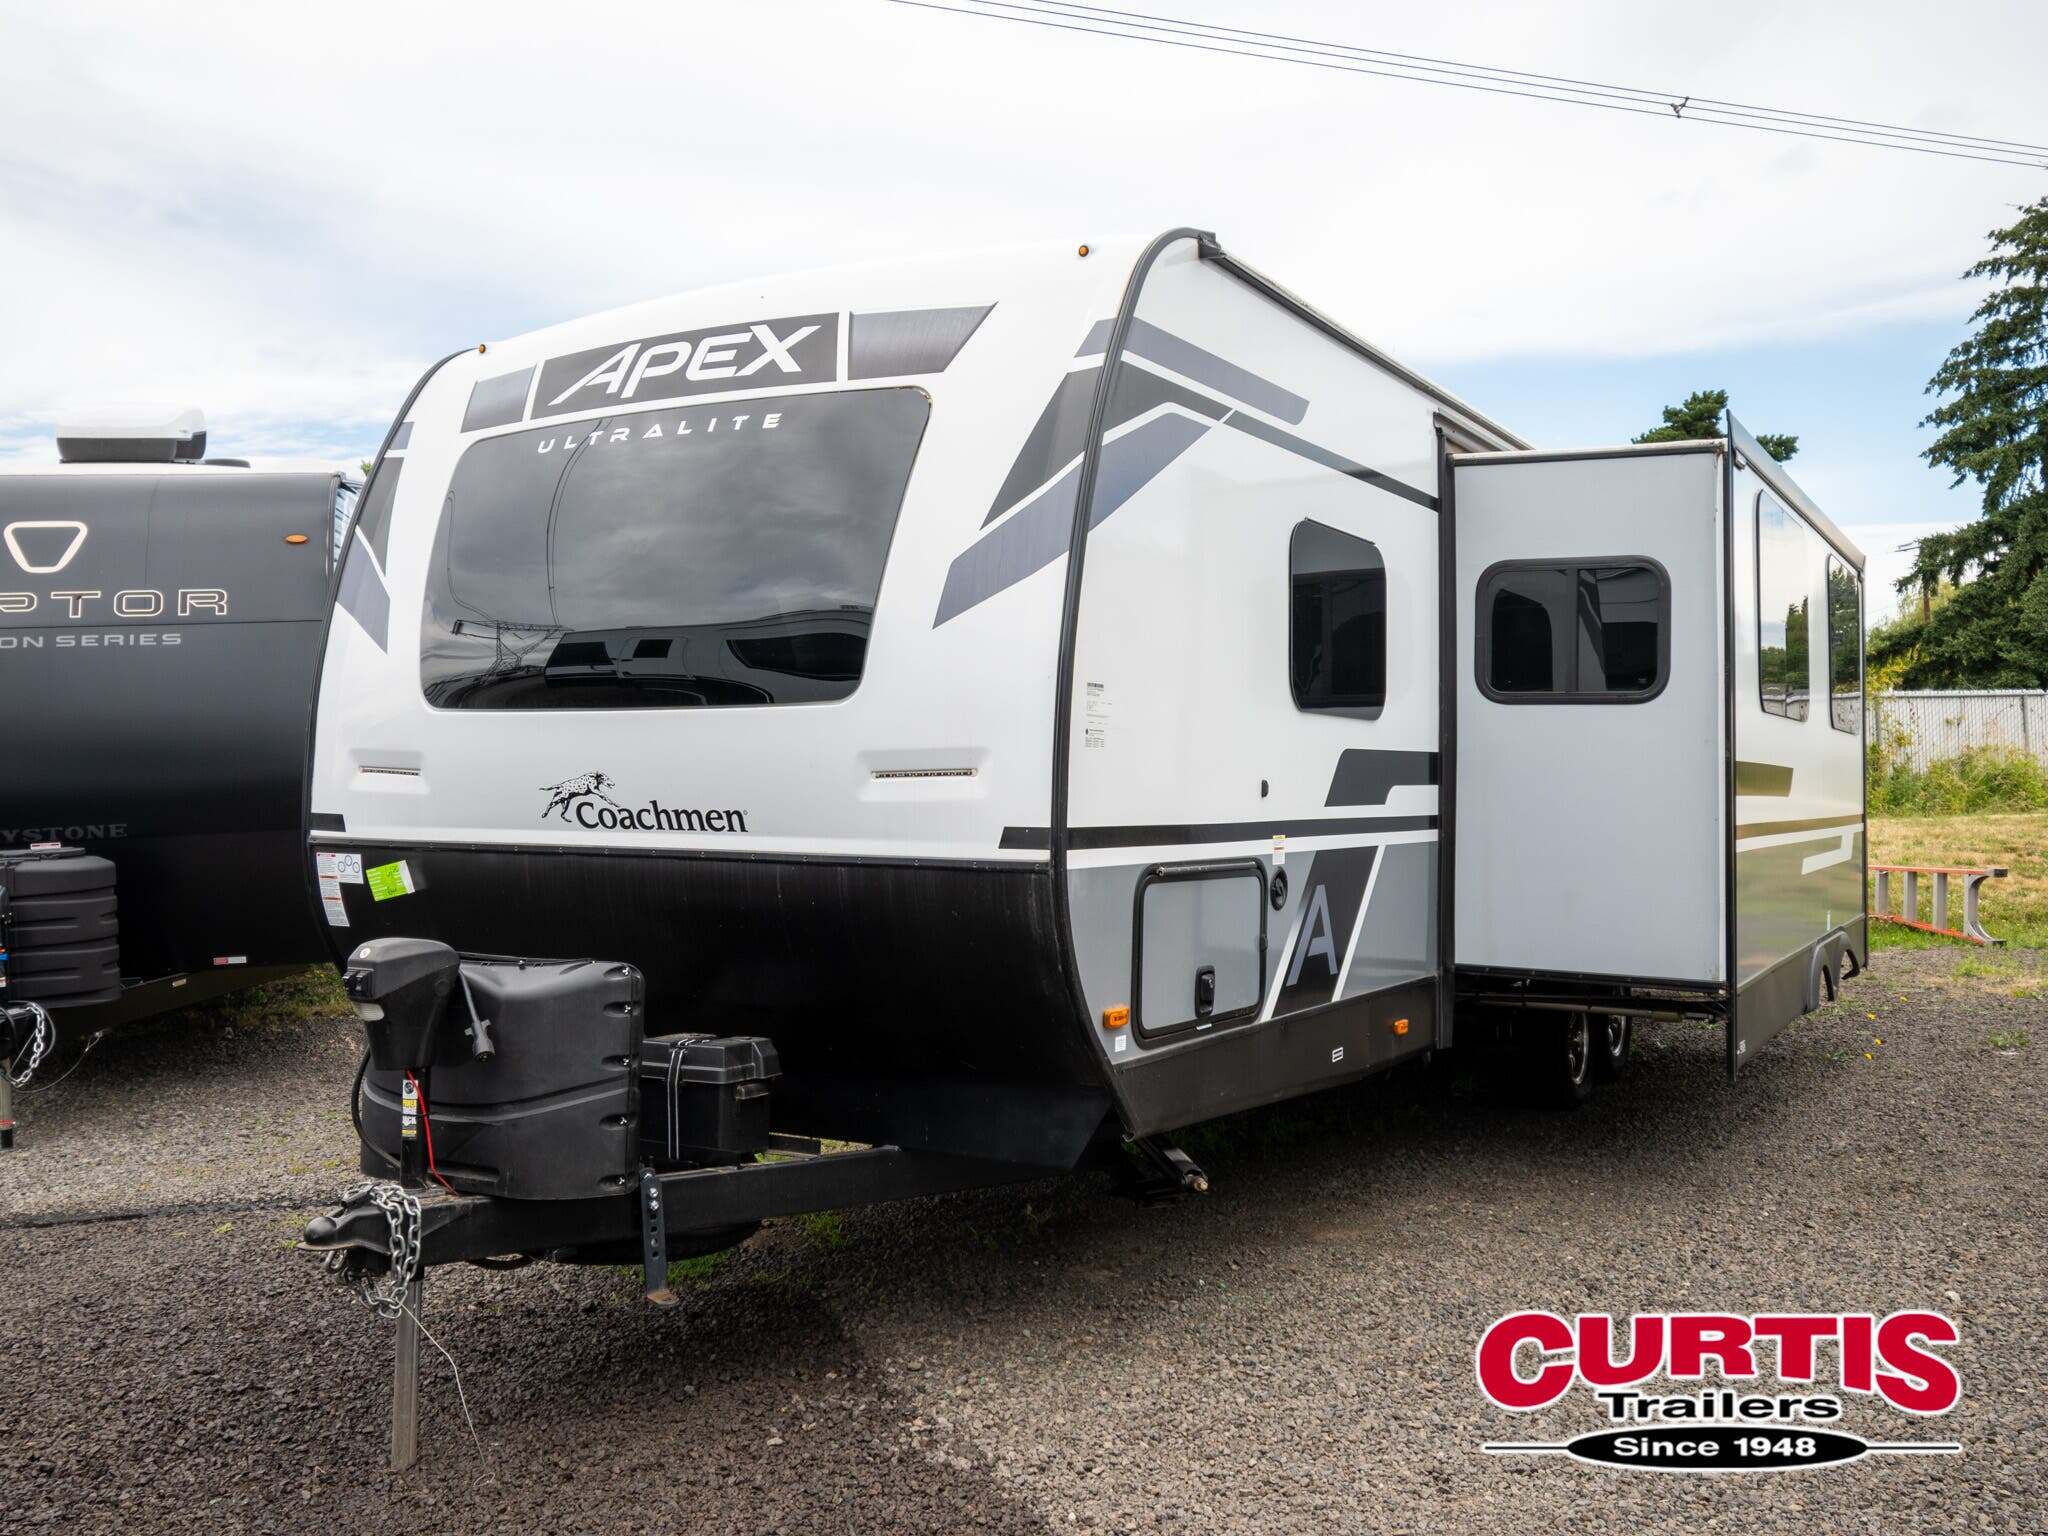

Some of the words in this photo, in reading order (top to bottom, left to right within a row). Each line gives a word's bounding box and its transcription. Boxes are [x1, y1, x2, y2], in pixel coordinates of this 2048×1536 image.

[548, 324, 821, 406] APEX
[537, 413, 783, 453] ULTRALITE
[56, 633, 181, 647] SERIES
[576, 800, 748, 832] Coachmen
